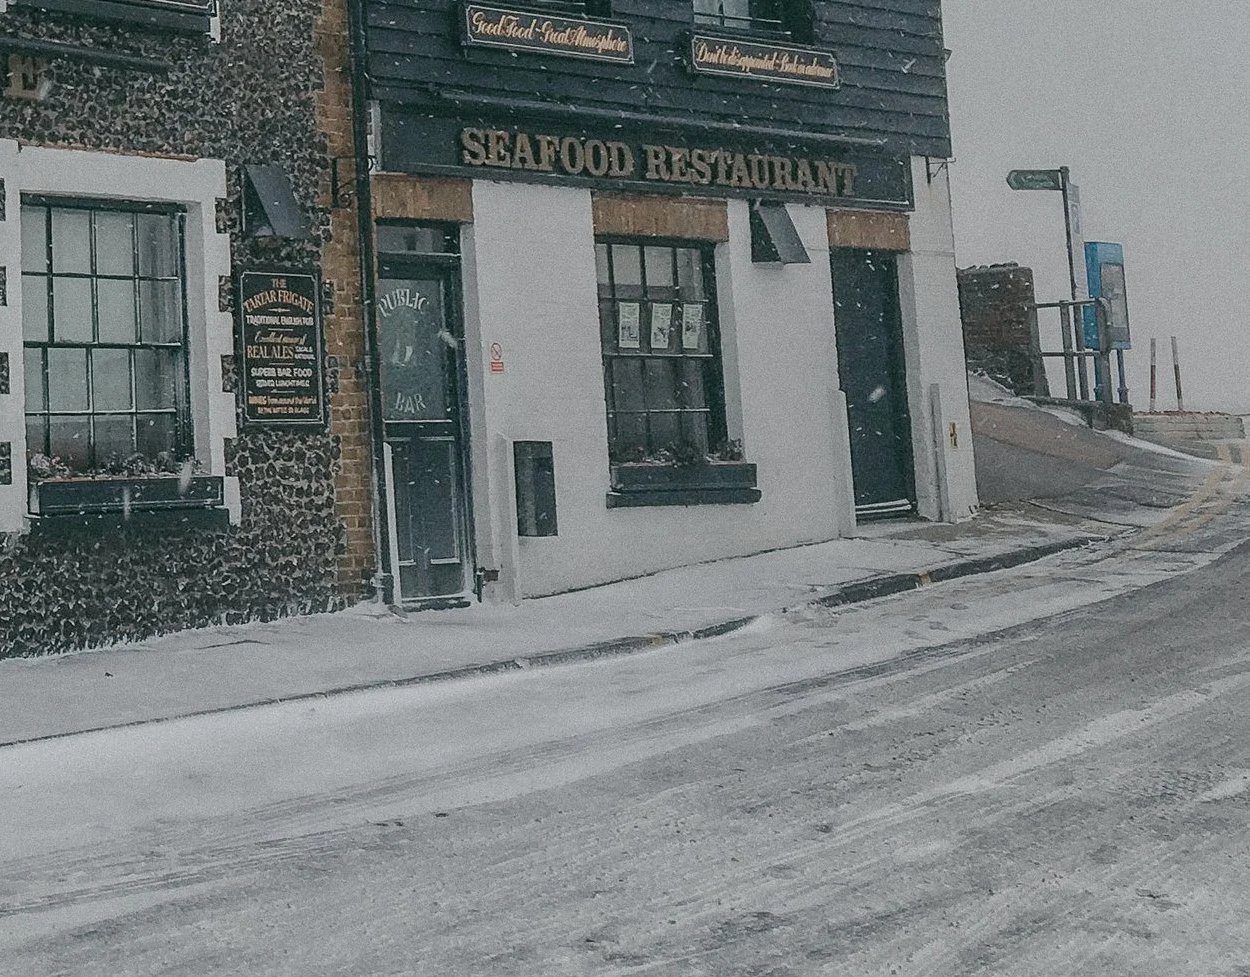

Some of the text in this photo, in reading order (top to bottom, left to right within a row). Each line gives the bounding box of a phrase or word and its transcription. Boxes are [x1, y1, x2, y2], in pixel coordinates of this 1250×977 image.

[473, 11, 506, 36] Good
[504, 15, 536, 40] Food
[540, 21, 571, 44] Great
[568, 25, 627, 53] Atmosphere
[461, 126, 858, 196] SEAFOOD RESTAURANT
[271, 278, 287, 288] THE
[243, 290, 315, 315] TARTAR FRIGATE
[376, 288, 430, 318] PUBLIC
[246, 345, 271, 359] REAL
[270, 345, 294, 359] ALES
[250, 367, 313, 378] SUPERB BAR FOOD
[395, 392, 426, 414] BAR
